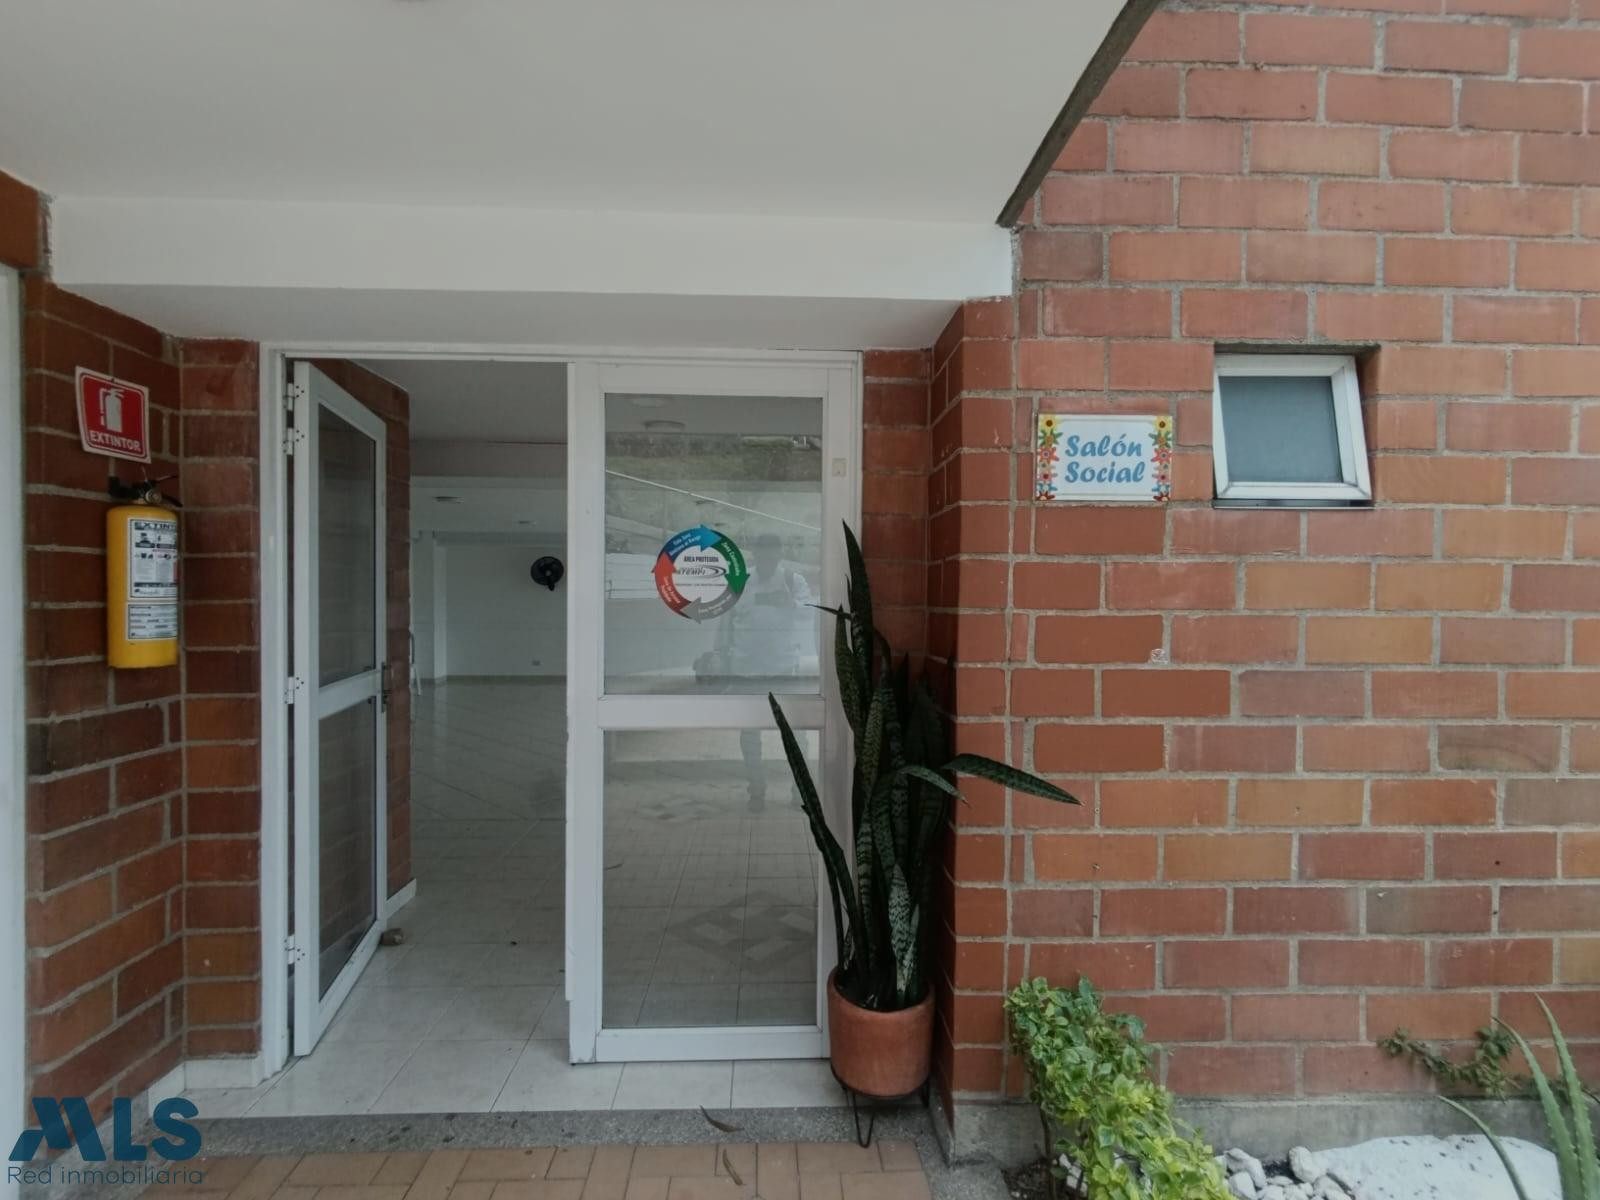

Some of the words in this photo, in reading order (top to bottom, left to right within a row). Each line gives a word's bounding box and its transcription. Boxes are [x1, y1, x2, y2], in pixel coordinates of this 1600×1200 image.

[89, 430, 142, 452] EXTINTOR
[1064, 433, 1143, 457] Salón
[1064, 461, 1147, 483] Social
